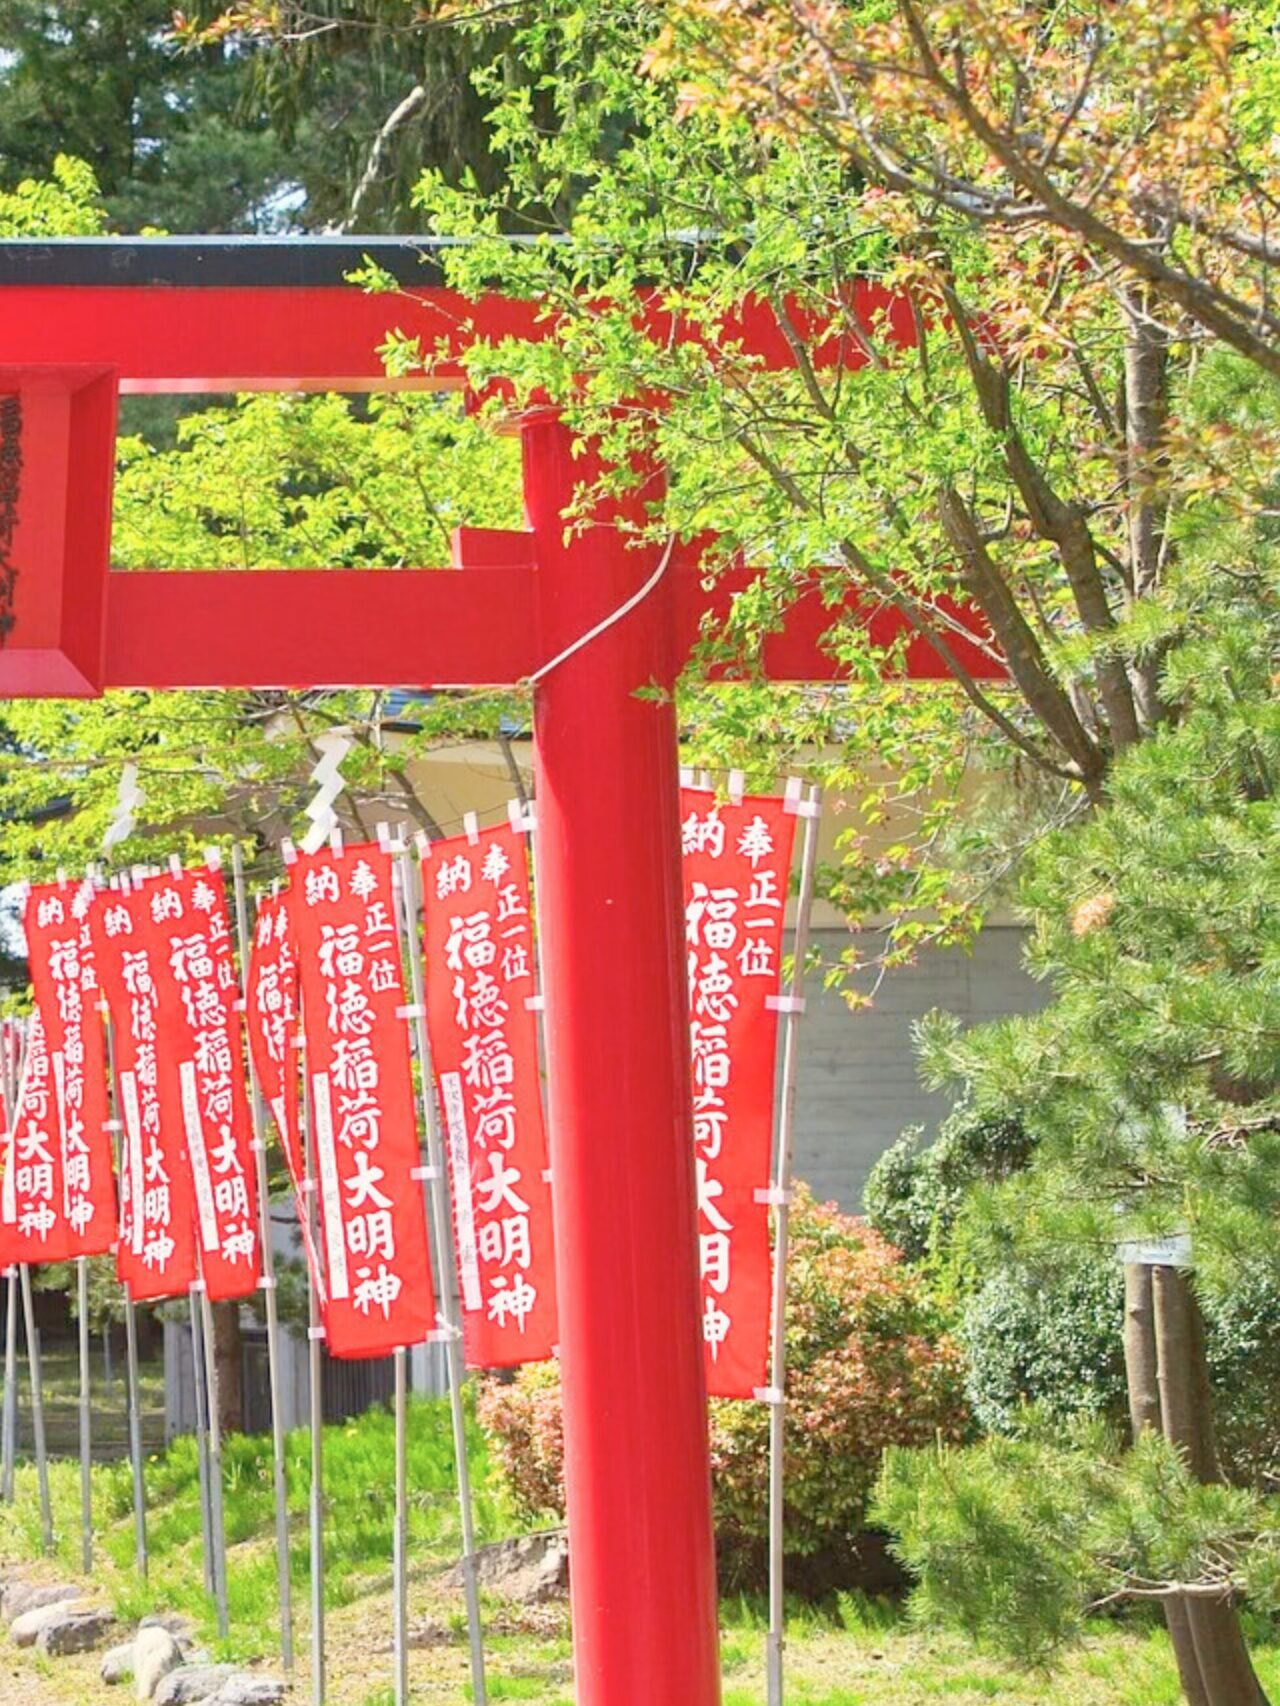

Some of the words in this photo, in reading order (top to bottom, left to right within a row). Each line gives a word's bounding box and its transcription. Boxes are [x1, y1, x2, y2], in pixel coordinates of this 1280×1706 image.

[208, 911, 237, 991] 正一位
[363, 901, 401, 994] 正一位
[495, 881, 532, 984] 正一位
[735, 870, 782, 978] 正一位
[121, 950, 176, 1274] 福徳稲荷大明神
[169, 934, 256, 1270] 福徳稲荷大明神
[318, 922, 402, 1321] 福徳稲荷大明神
[443, 910, 538, 1335] 福徳稲荷大明神
